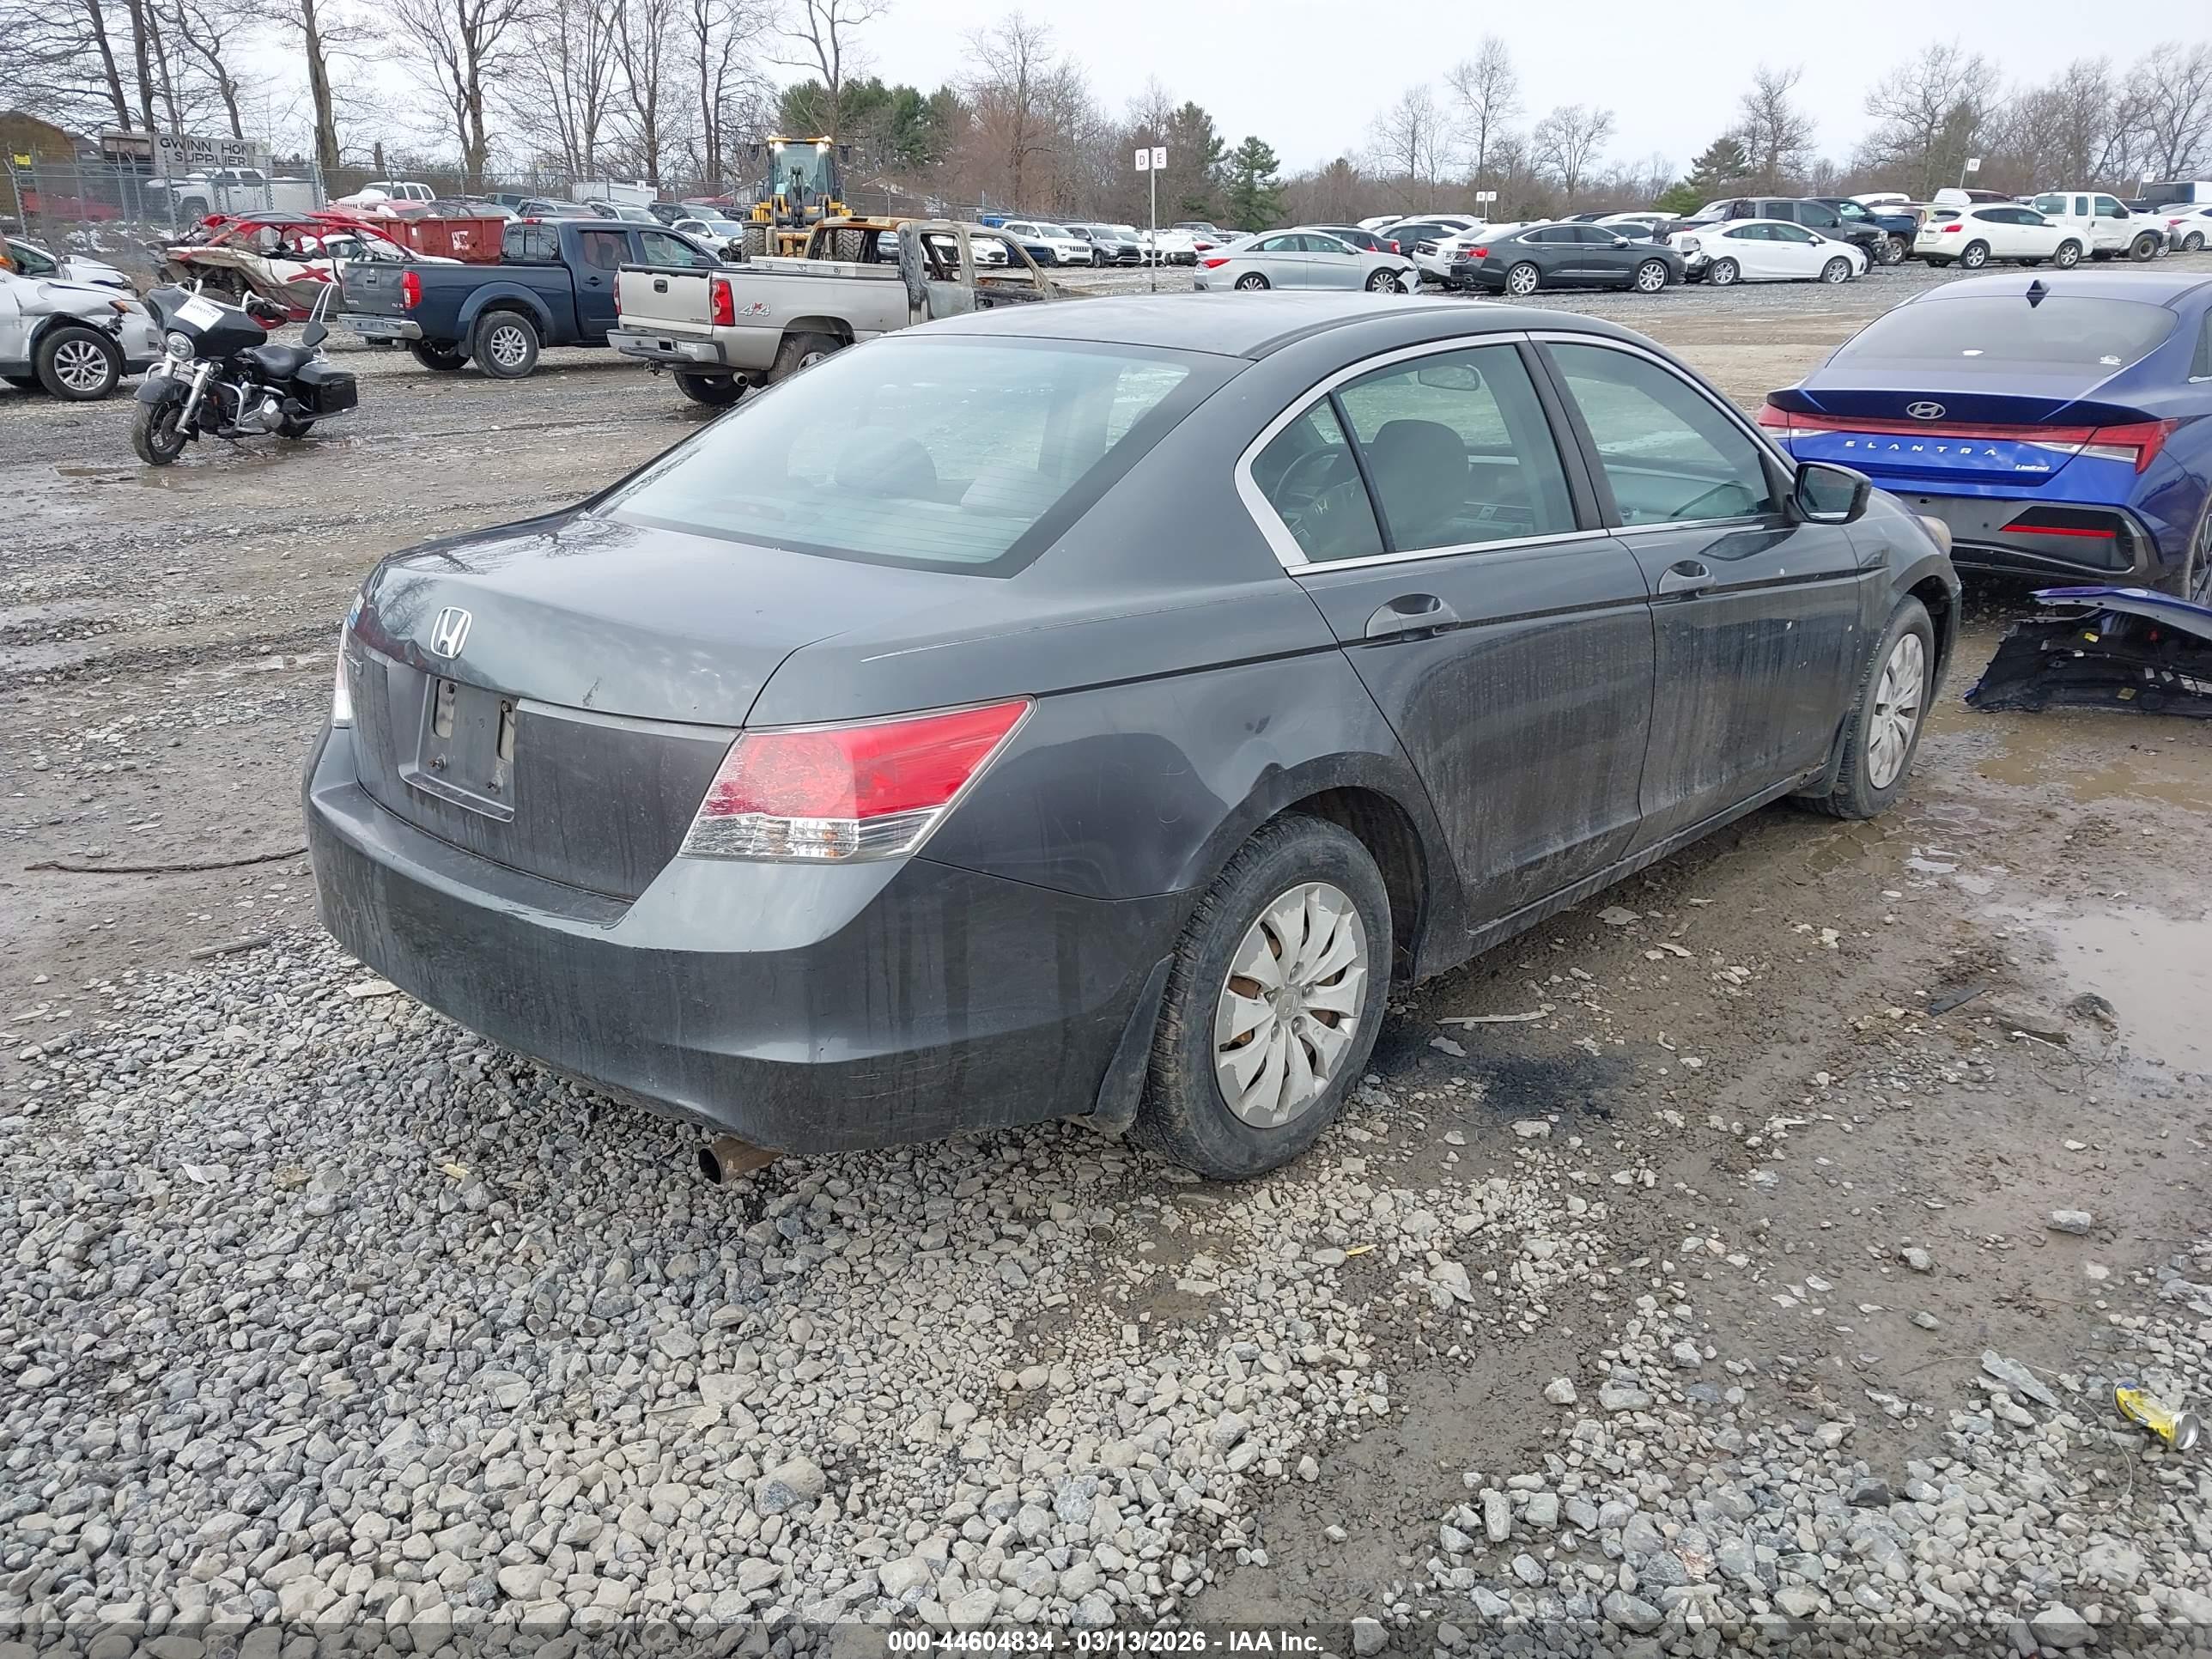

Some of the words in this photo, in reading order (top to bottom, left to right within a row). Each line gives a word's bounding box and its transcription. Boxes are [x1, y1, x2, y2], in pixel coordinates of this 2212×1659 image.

[160, 137, 212, 152] GWINN
[1139, 155, 1146, 166] D
[1157, 153, 1163, 164] E
[1845, 441, 1996, 456] ELANTRA
